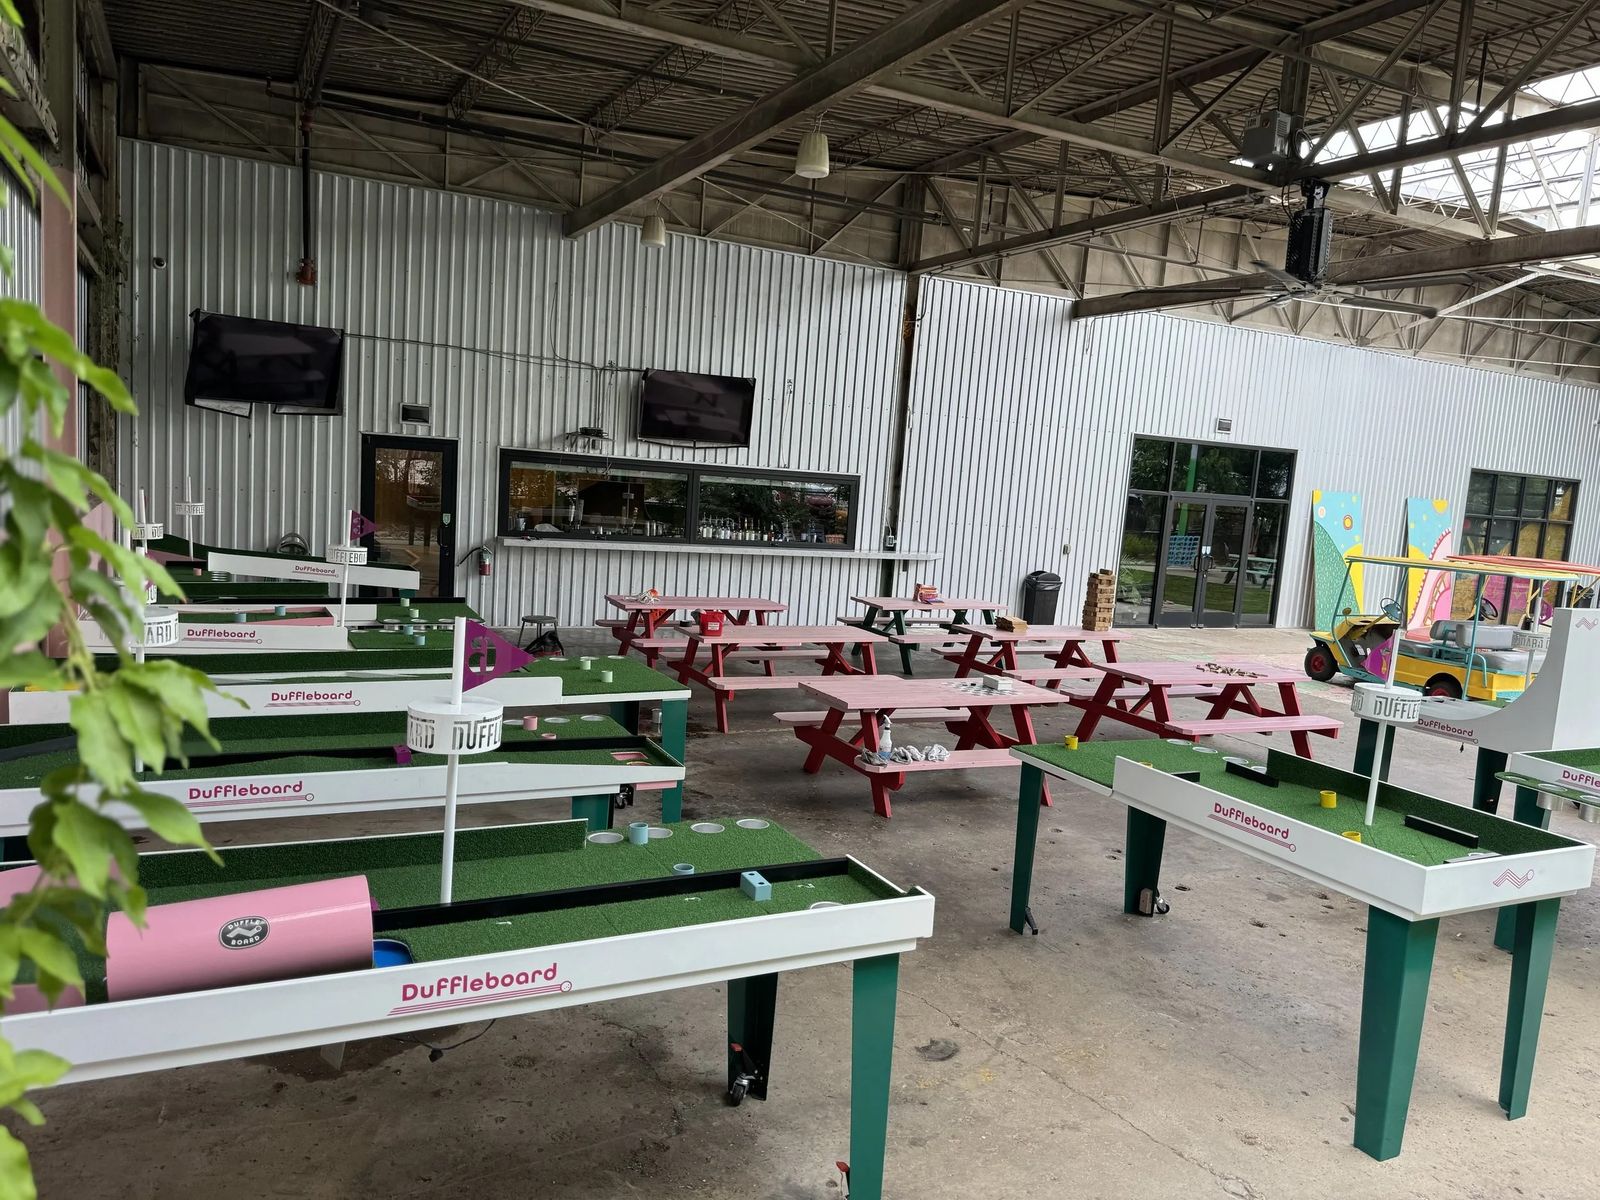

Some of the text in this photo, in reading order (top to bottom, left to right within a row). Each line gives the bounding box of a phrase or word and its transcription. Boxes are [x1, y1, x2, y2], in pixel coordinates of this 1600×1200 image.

[295, 565, 335, 574] Duffleboard
[187, 628, 256, 638] Duffleboard
[271, 690, 353, 701] Duffleboard
[1417, 718, 1474, 737] Duffleboard
[189, 781, 302, 800] Duffleboard
[1214, 802, 1289, 839] Duffleboard
[227, 919, 262, 930] DUFFLE
[231, 936, 260, 945] BOARD
[402, 963, 557, 1001] Duffleboard
